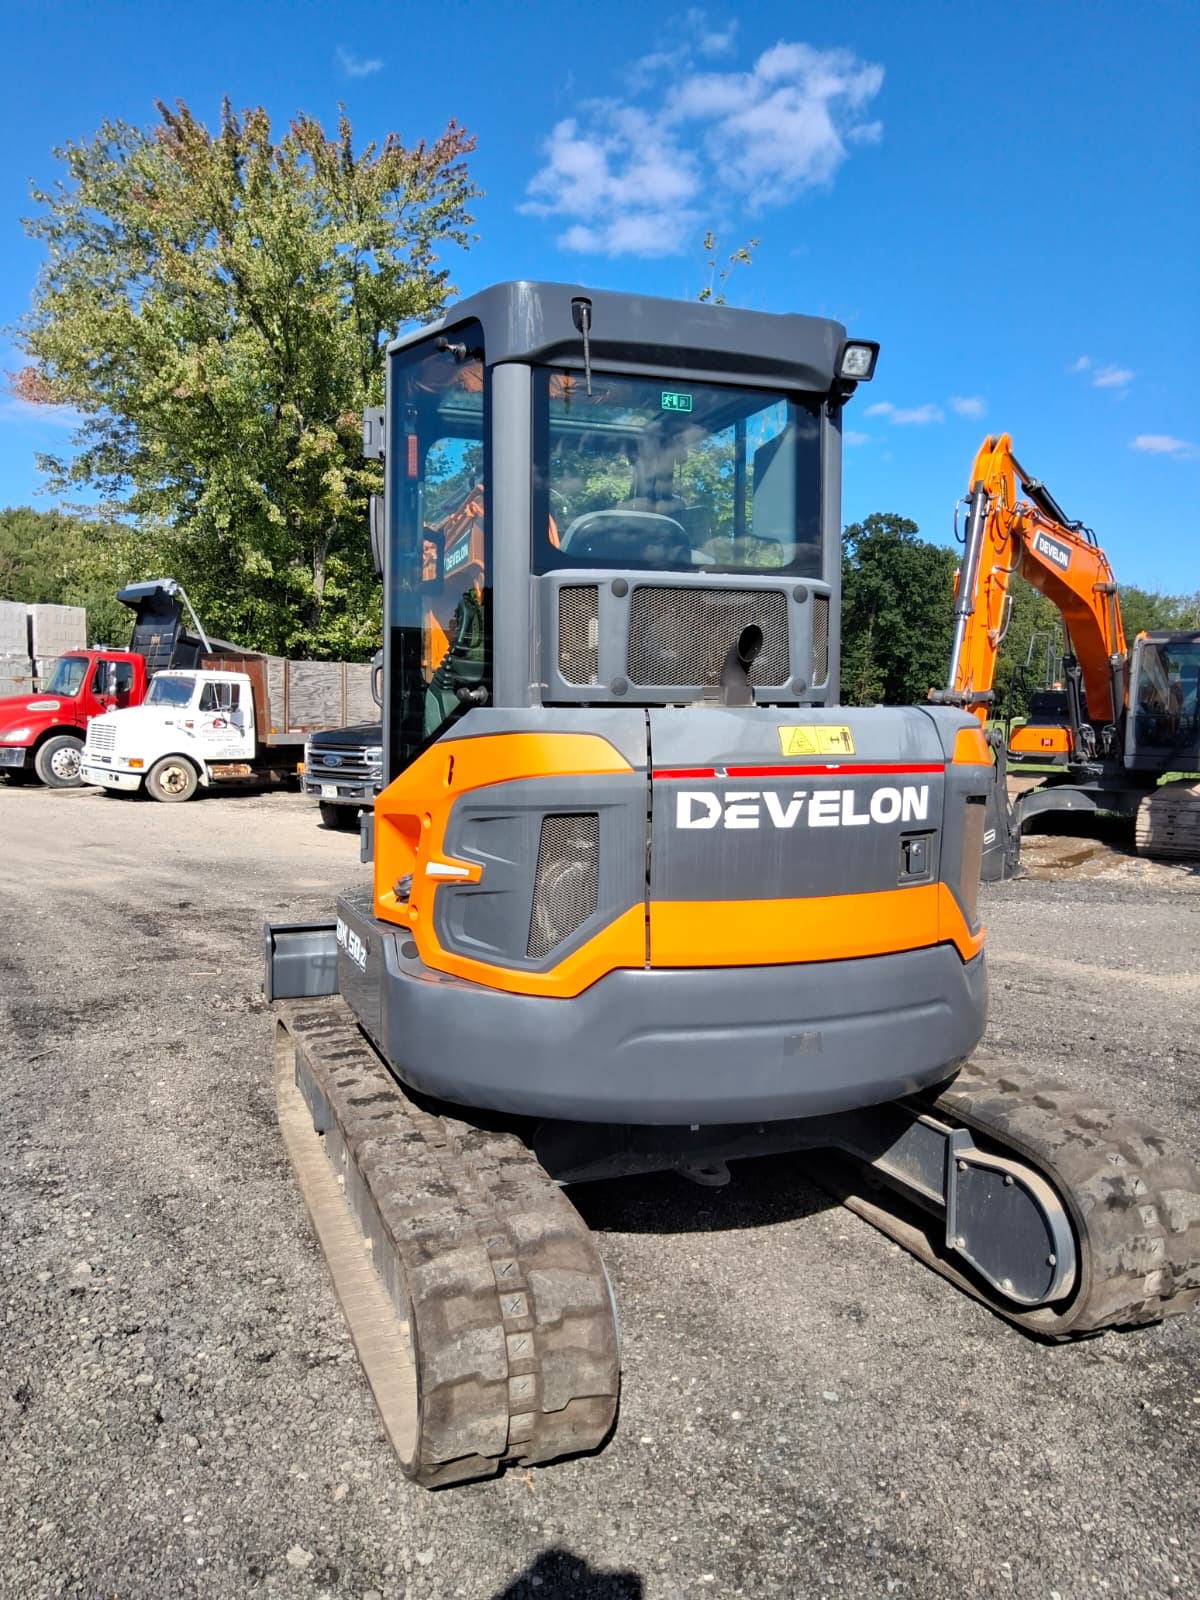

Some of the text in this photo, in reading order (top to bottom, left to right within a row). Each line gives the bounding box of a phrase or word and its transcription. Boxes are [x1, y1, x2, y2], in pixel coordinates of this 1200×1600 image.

[446, 543, 469, 571] DEVELON
[1039, 538, 1068, 567] DEVELON
[676, 785, 929, 829] DEVELON
